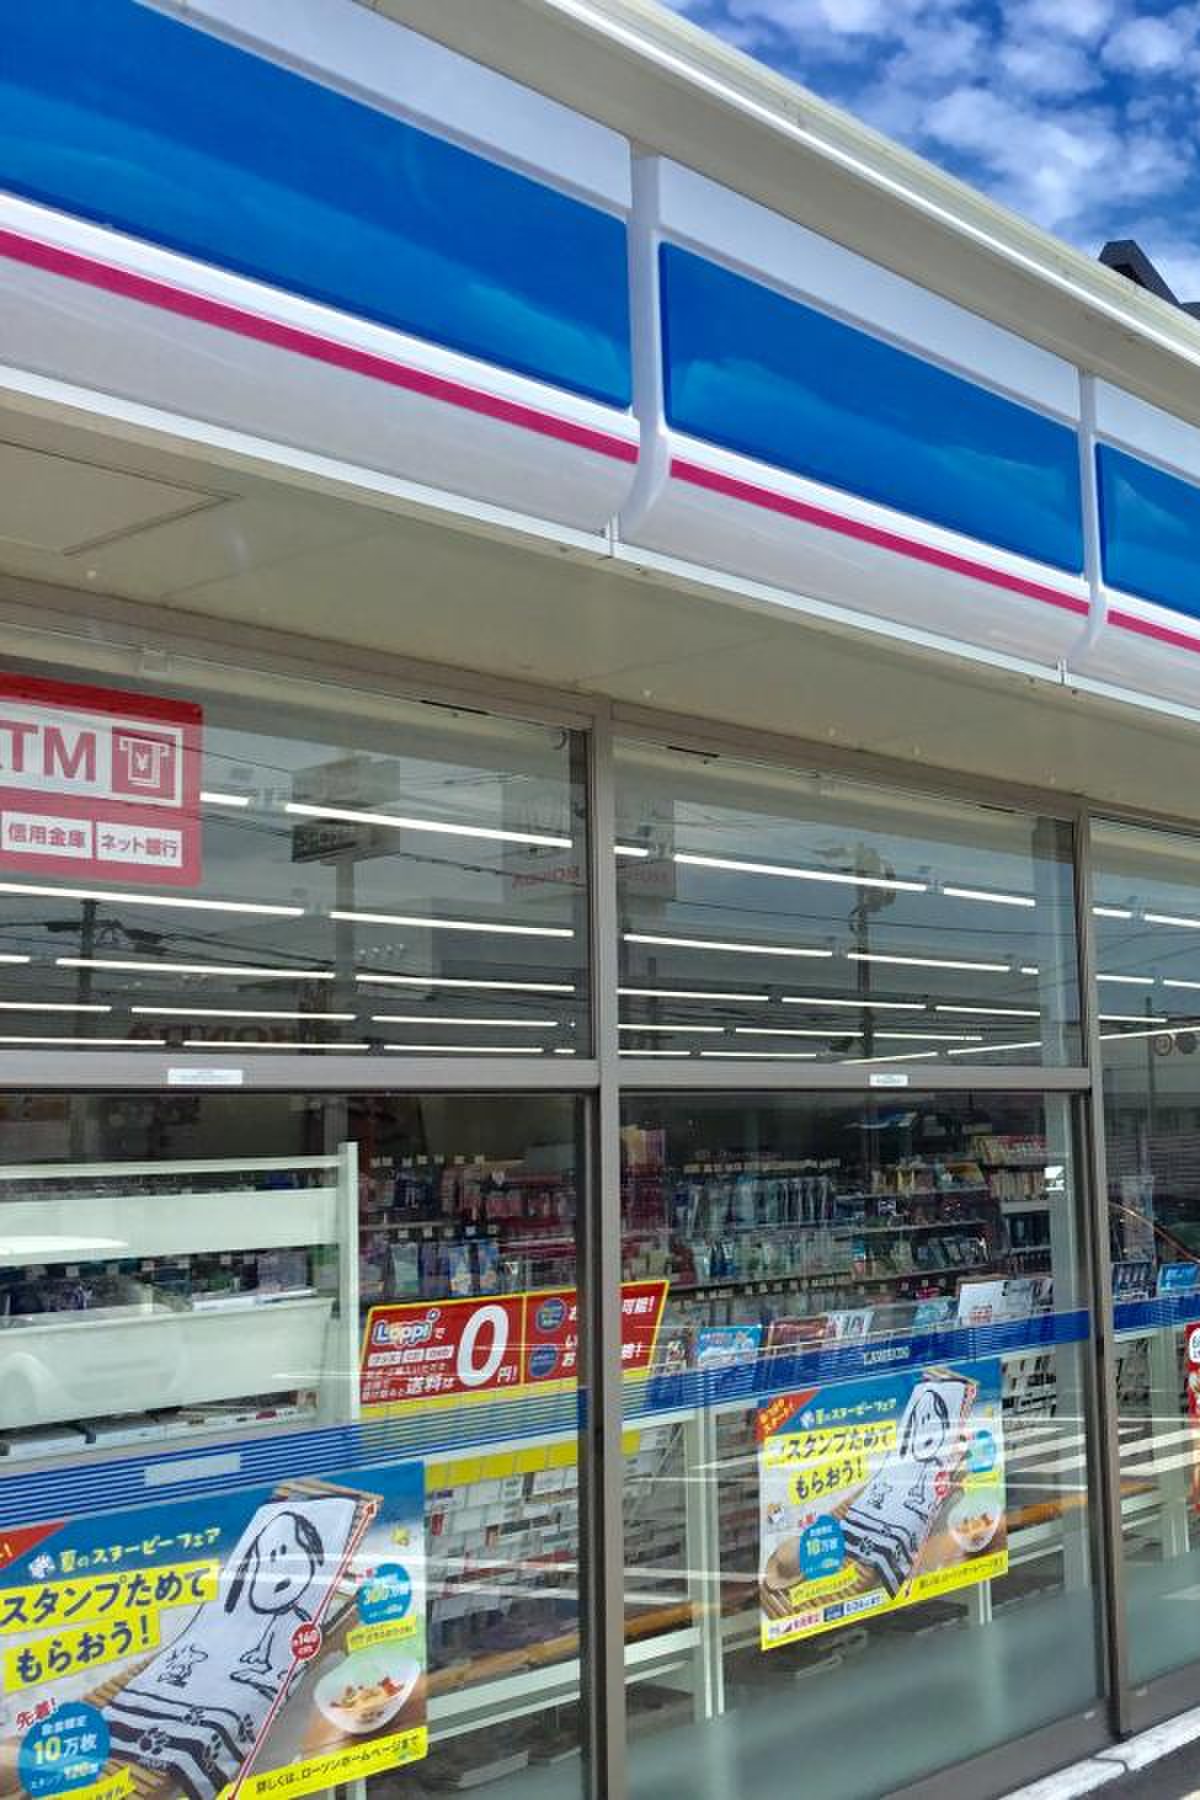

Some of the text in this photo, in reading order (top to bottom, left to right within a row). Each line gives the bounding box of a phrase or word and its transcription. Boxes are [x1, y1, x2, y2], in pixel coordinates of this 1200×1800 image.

[0, 718, 97, 783] TM
[8, 822, 86, 849] 信用金庫
[101, 833, 178, 859] ネット銀行
